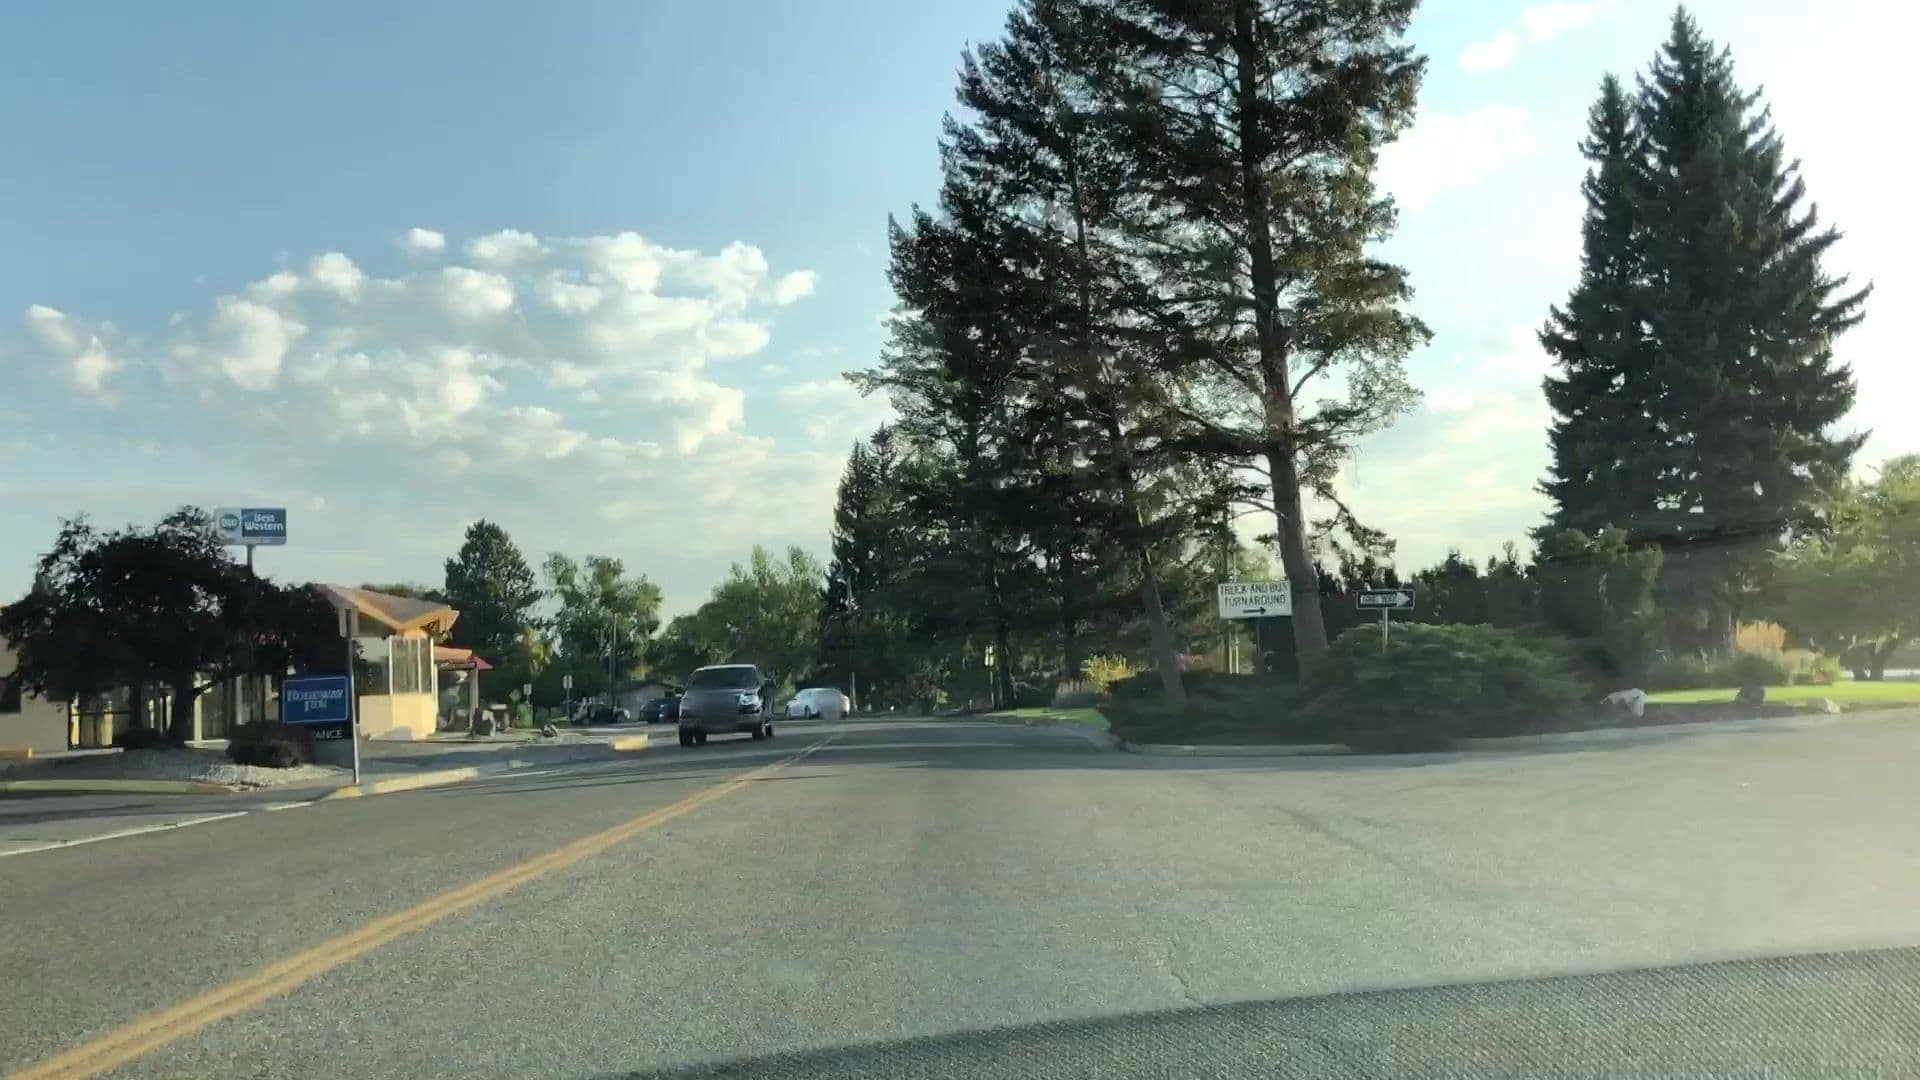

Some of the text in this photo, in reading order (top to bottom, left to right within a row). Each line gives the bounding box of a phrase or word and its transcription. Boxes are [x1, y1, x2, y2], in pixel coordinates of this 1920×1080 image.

[245, 512, 283, 531] Best Western
[1220, 585, 1247, 596] TRUCK
[1250, 583, 1268, 593] AND
[1225, 594, 1286, 607] TURNAROUND
